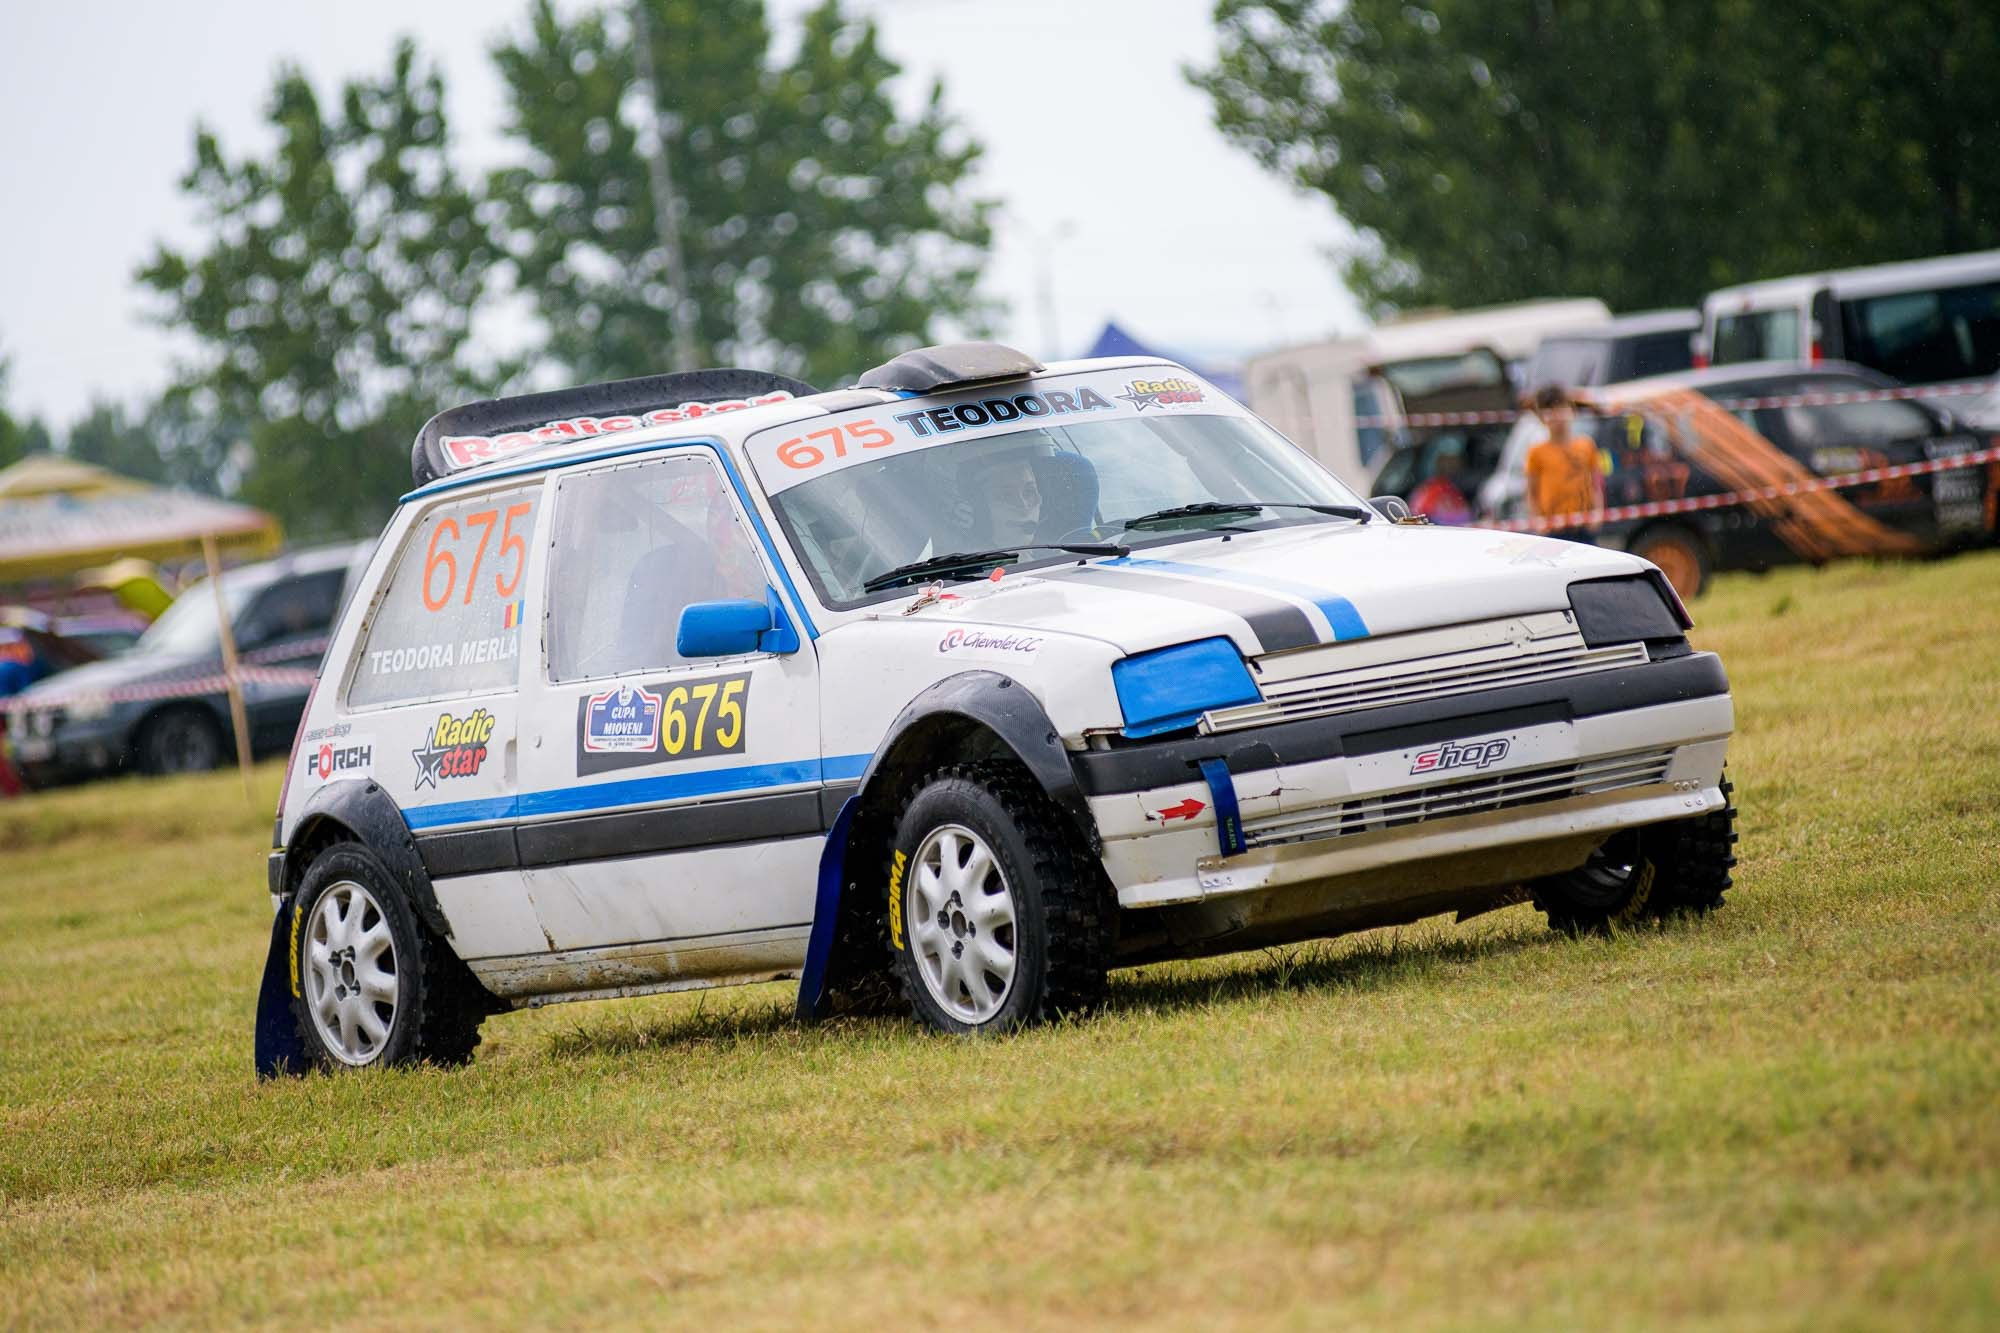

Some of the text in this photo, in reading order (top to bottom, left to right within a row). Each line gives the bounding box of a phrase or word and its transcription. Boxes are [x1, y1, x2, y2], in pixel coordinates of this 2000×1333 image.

[444, 415, 637, 468] Radic
[776, 387, 1113, 470] 675 TEODORA
[422, 502, 532, 613] 675
[371, 634, 519, 675] TEODORA MERLA
[962, 632, 1016, 650] Chevrolet
[433, 707, 495, 748] Radic
[603, 722, 643, 735] MIOVENI
[611, 706, 637, 720] CUPA
[661, 679, 745, 755] 675
[438, 745, 488, 779] star
[1410, 739, 1510, 775] shop
[889, 848, 907, 951] FEDIMA
[289, 904, 303, 998] FEDIMA
